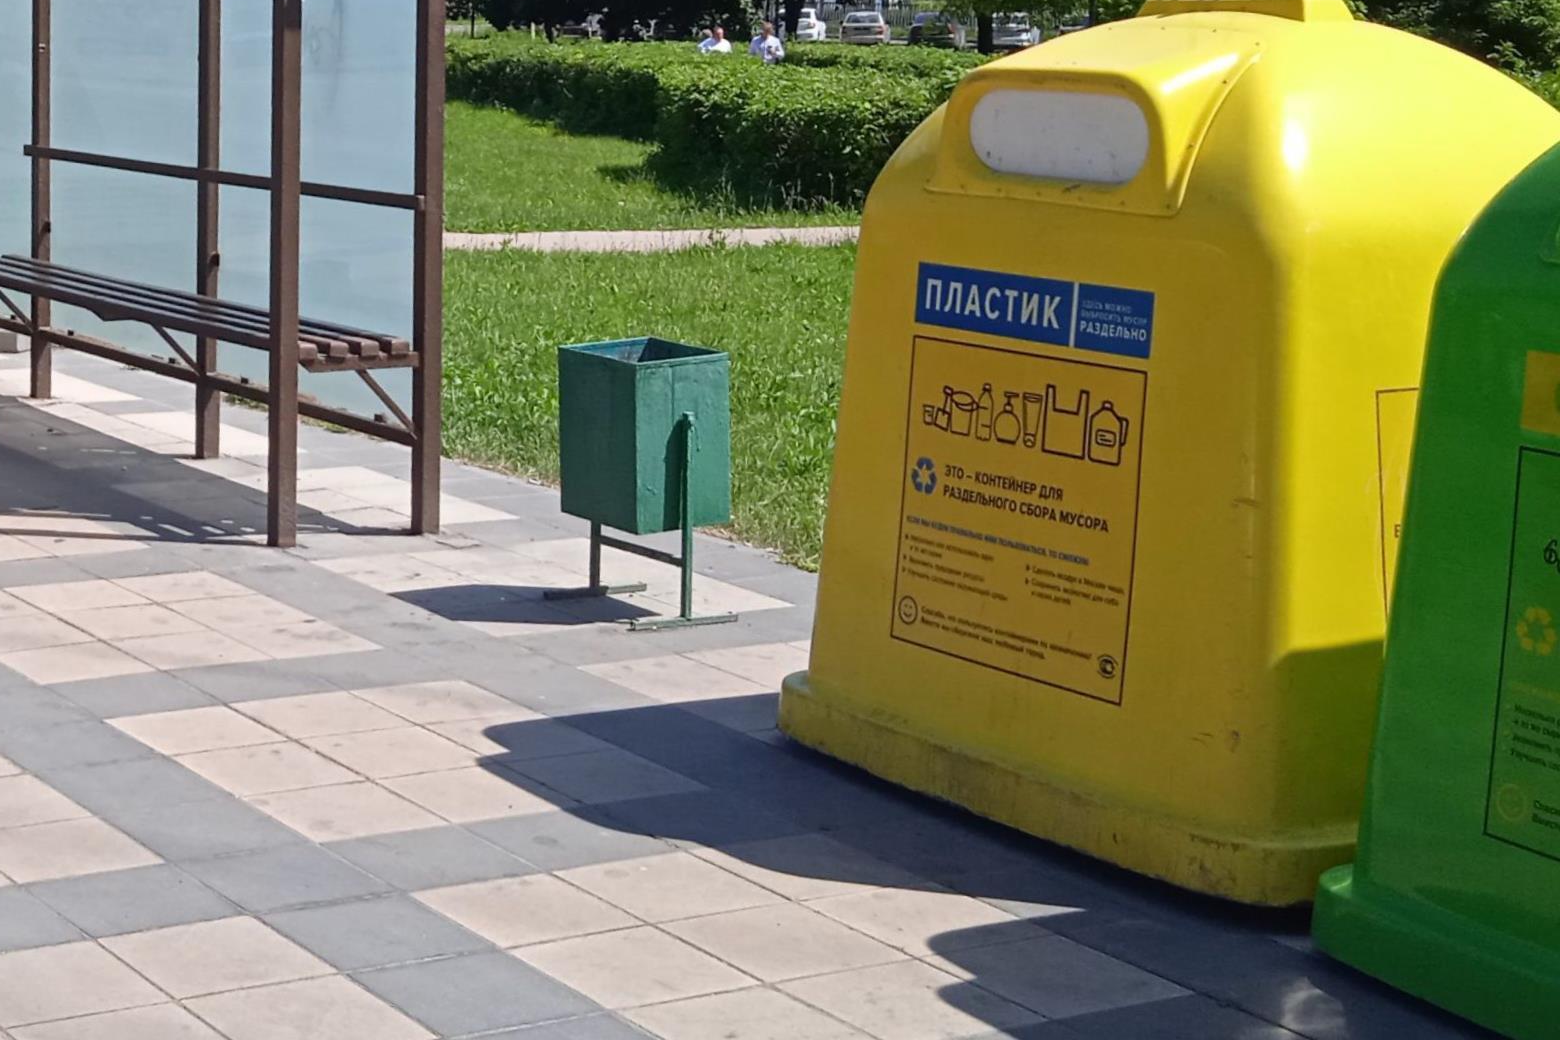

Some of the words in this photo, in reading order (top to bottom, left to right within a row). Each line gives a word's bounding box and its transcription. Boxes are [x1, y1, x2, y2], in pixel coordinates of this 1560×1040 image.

[925, 278, 1062, 330] ПЛАСТИК
[1080, 320, 1148, 342] РАЗДЕЛЬНО
[944, 464, 965, 480] ЭТО
[974, 471, 1037, 495] КОНТЕЙНЕР
[1039, 484, 1064, 501] ДЛЯ
[943, 484, 1017, 513] РАЗДЕЛЬНОГО
[1019, 502, 1057, 522] СБОРА
[1059, 510, 1109, 533] МУСОРА
